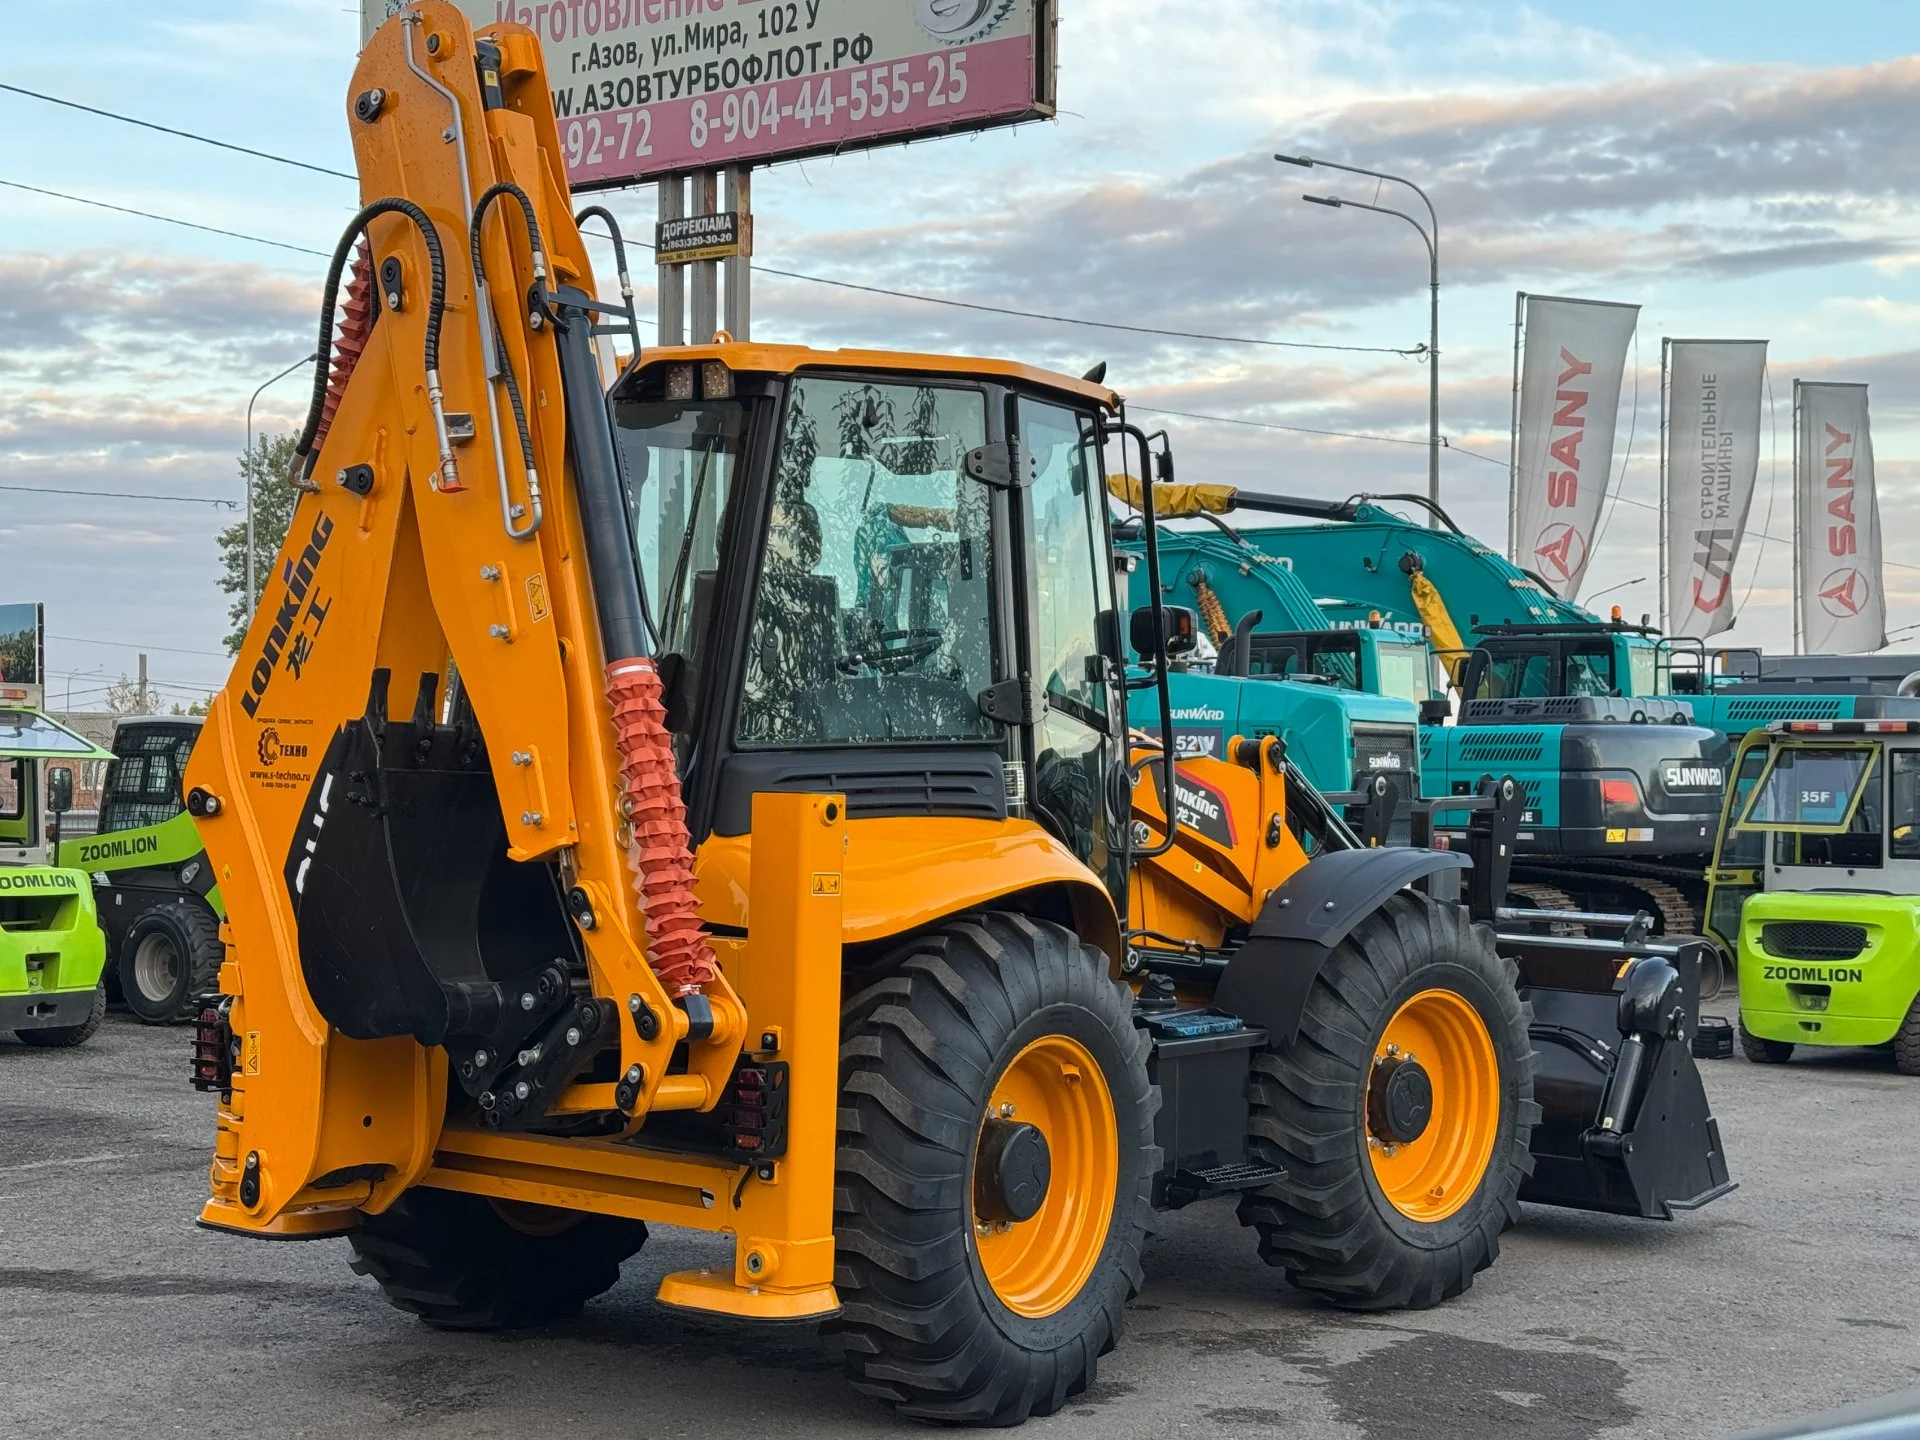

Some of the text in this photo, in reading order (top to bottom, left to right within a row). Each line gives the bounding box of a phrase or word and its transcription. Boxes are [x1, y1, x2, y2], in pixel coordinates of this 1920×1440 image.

[572, 41, 643, 74] г.Азов,
[651, 20, 748, 66] ул.Мира,
[758, 3, 798, 39] 102
[690, 52, 968, 148] 8-904-44-555-25
[662, 215, 732, 240] ДОРРЕКЛАМА
[1547, 345, 1592, 508] SANY
[1700, 373, 1717, 520] СТРОИТЕЛЬНЫЕ
[1716, 432, 1734, 518] МАШИНЫ
[1825, 422, 1857, 557] SANY
[286, 585, 332, 681] 龙工
[250, 770, 310, 781] www.s-techno.ru
[1369, 752, 1401, 768] SUNWARD
[1666, 767, 1722, 786] SUNWARD
[80, 835, 157, 863] ZOOMLION
[1763, 966, 1863, 983] ZOOMLION
